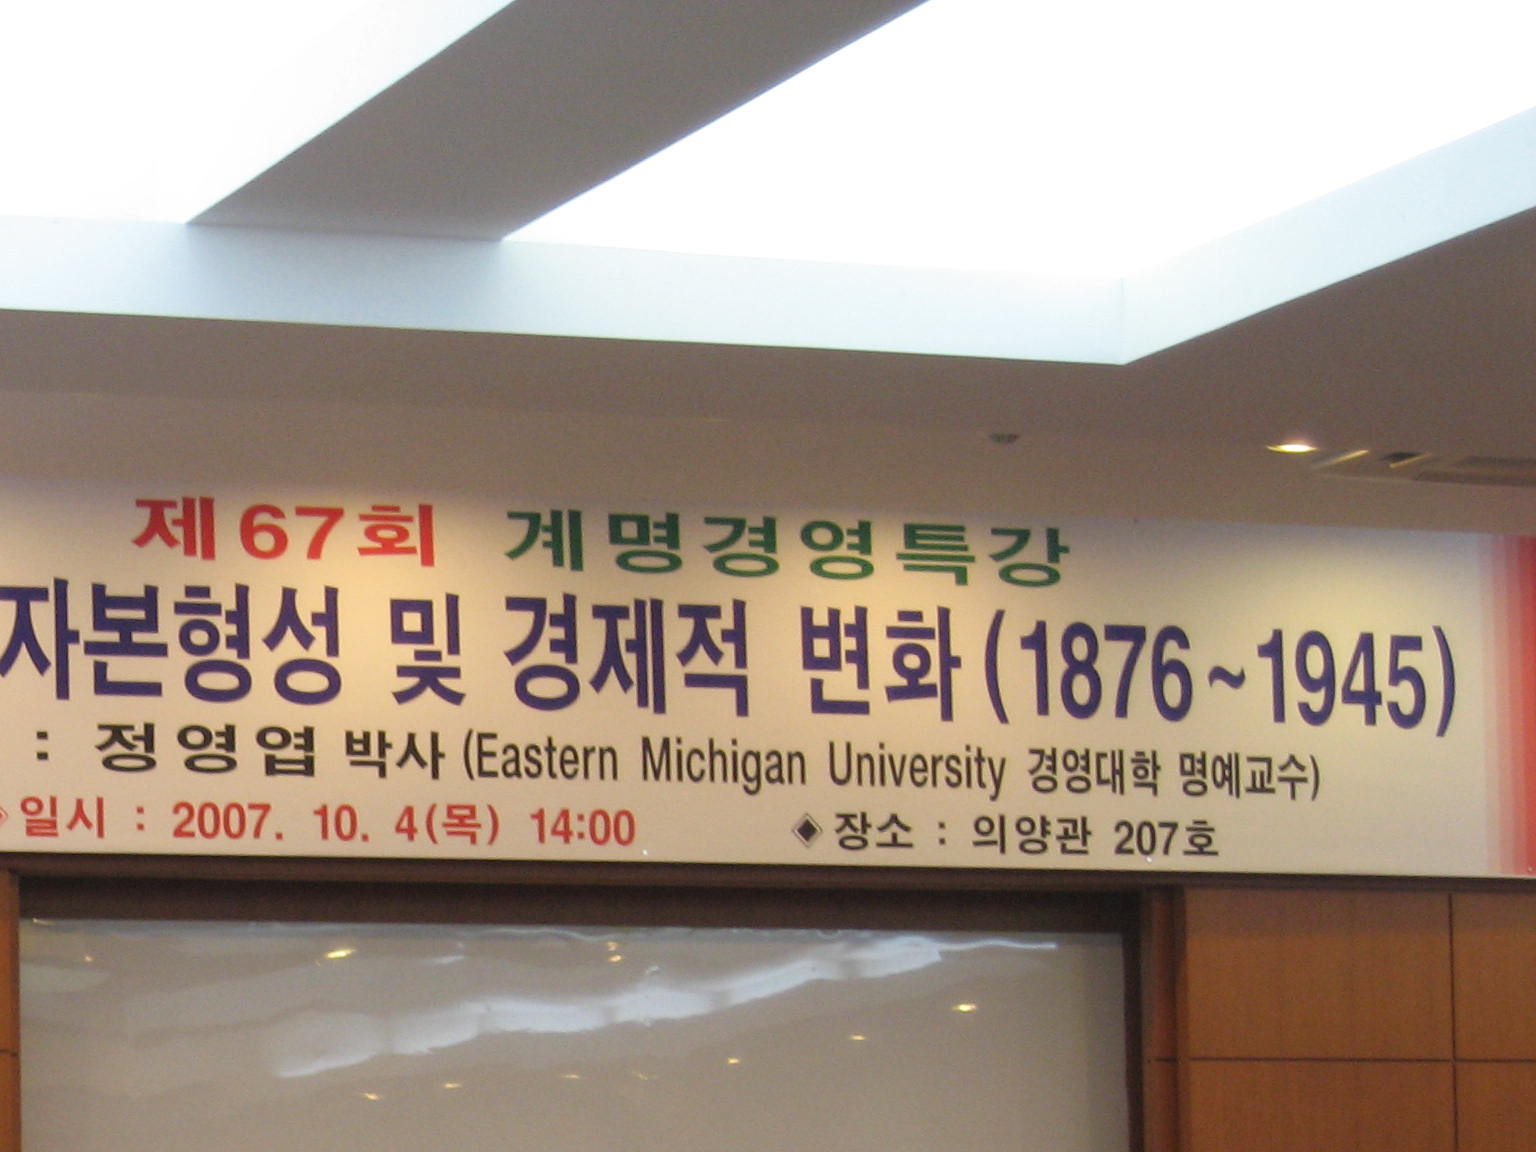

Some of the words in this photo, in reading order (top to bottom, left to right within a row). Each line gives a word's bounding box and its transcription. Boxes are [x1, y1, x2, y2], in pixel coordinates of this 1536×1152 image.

[389, 592, 467, 706] 및
[503, 591, 749, 717] 경제적
[94, 721, 316, 778] 정영엽
[641, 735, 807, 796] Michigan
[828, 740, 1007, 802] University
[1028, 746, 1162, 797] 경영대학
[1179, 750, 1321, 802] 명예교수)
[20, 795, 105, 839] 일시
[172, 801, 283, 840] 2007.
[313, 803, 369, 842] 10.
[530, 807, 637, 847] 14:00
[834, 810, 914, 851] 장소
[972, 813, 1093, 856] 의양관
